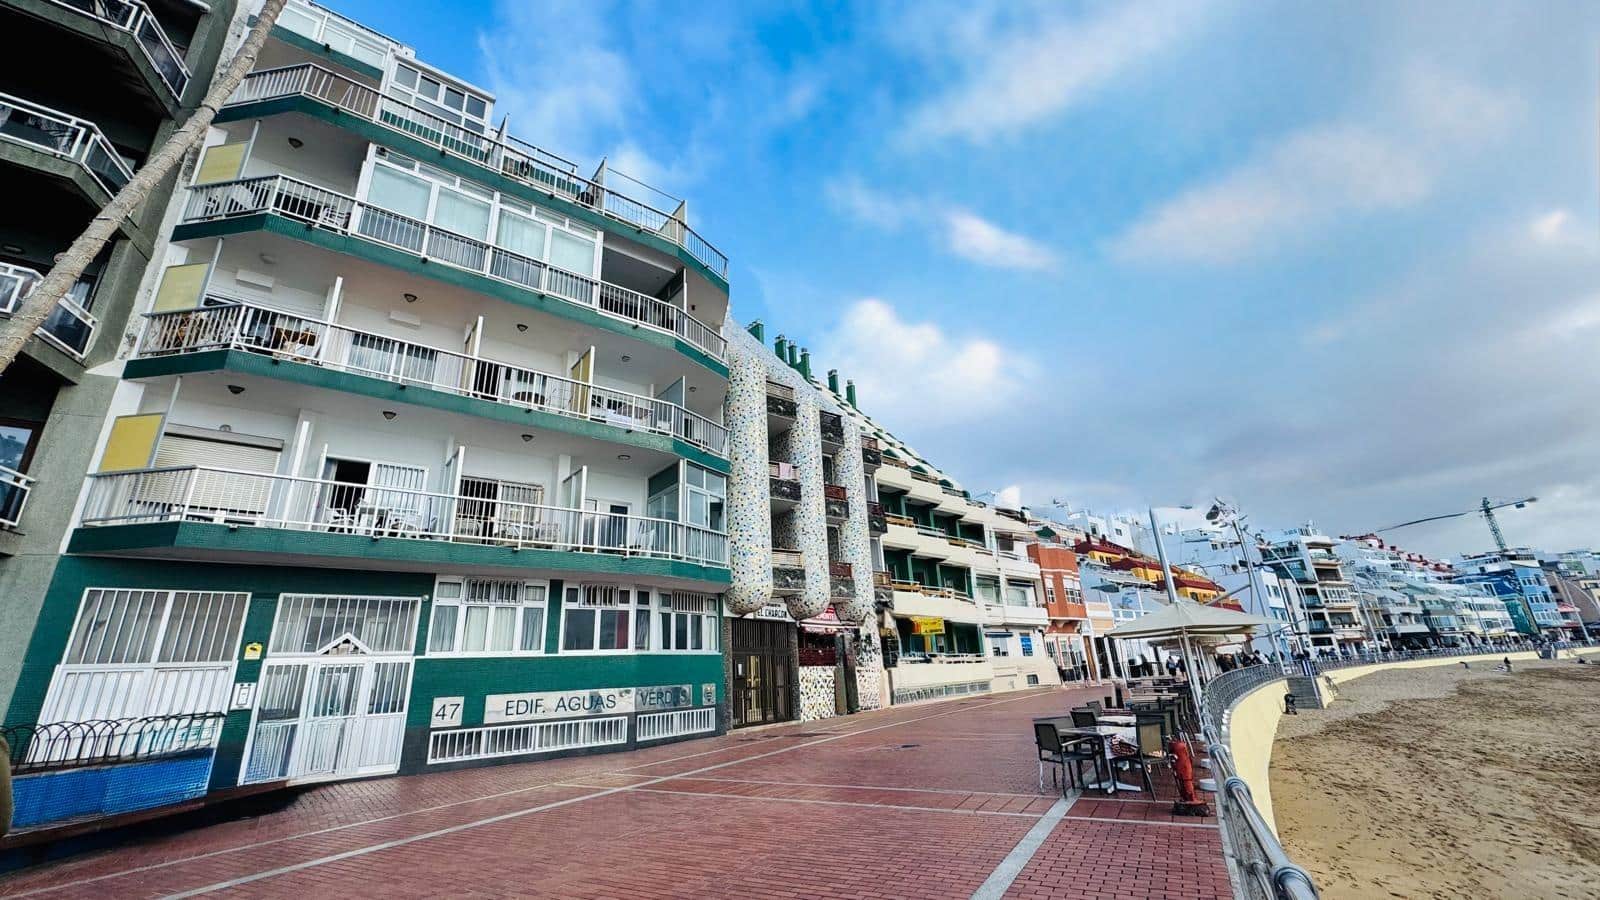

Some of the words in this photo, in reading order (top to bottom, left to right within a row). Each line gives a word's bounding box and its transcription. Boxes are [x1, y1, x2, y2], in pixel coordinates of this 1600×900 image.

[757, 607, 764, 616] EL
[504, 698, 546, 717] EDIF.
[555, 694, 617, 713] AGUAS
[640, 688, 687, 706] VERDS
[435, 703, 461, 721] 47
